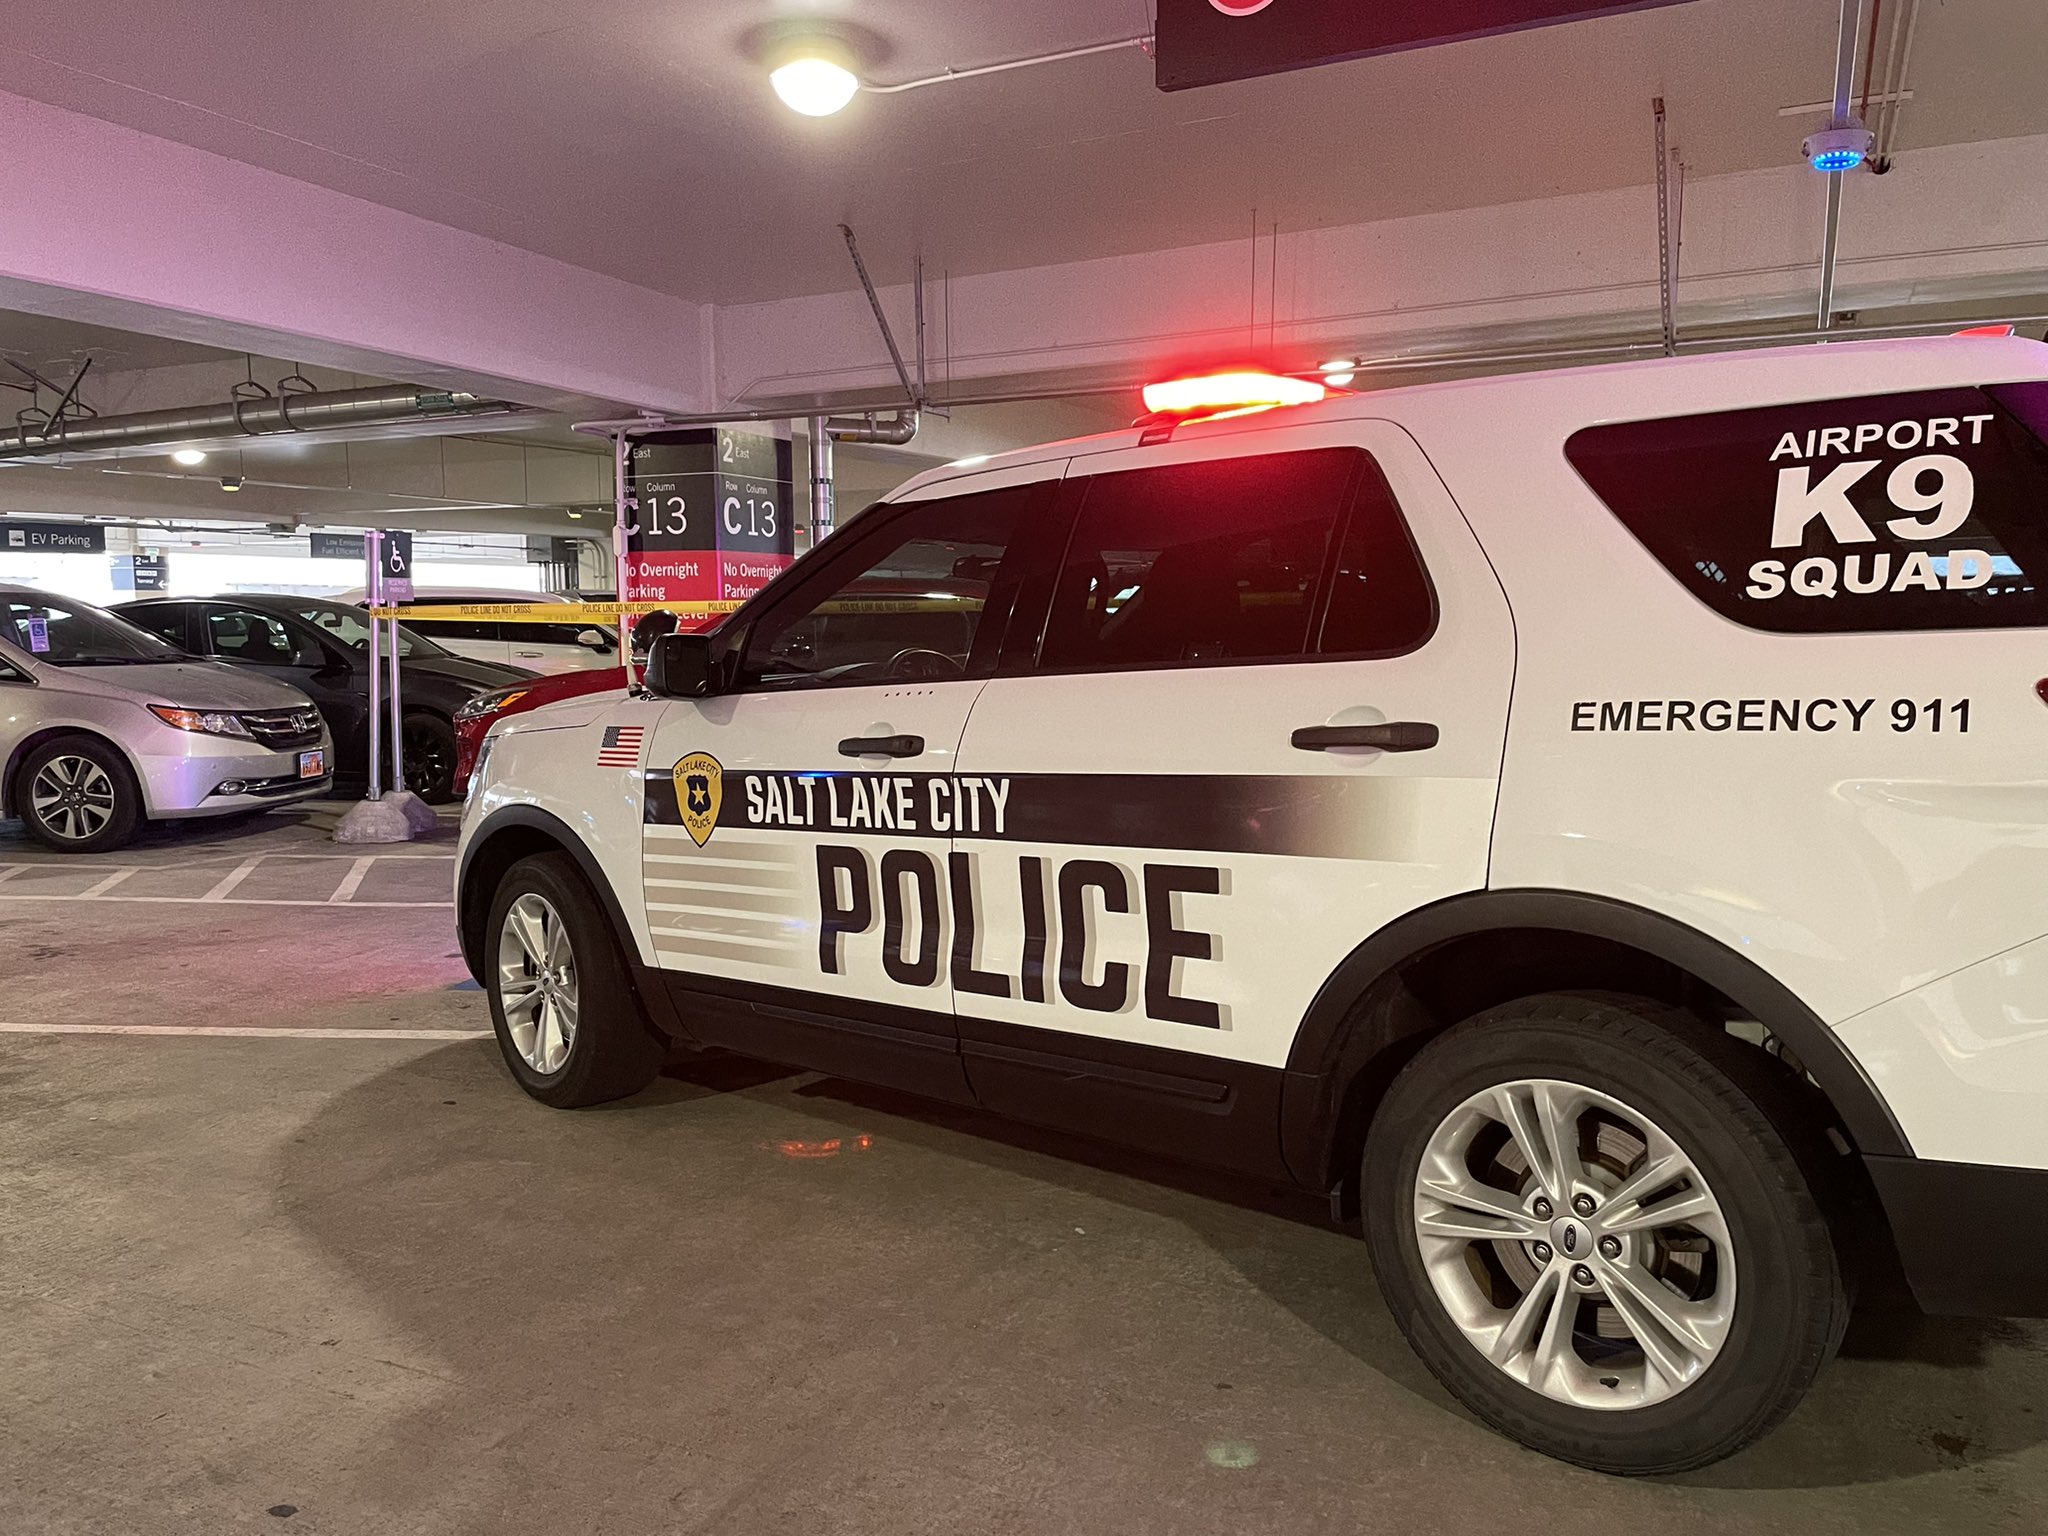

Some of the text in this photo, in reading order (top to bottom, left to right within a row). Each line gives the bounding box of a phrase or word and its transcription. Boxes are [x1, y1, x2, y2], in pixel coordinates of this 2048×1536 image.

[1769, 414, 1994, 461] AIRPORT
[633, 449, 651, 459] East
[722, 437, 750, 463] 2 East
[647, 483, 676, 493] Column
[725, 481, 768, 495] Row Column
[1771, 454, 1974, 549] K9
[647, 497, 687, 535] 13
[723, 496, 776, 538] C 13
[31, 533, 91, 547] EV Parking
[640, 562, 699, 579] Overnight
[723, 562, 782, 581] No Overnight
[1746, 549, 1993, 600] SQUAD
[393, 606, 411, 616] CROSS
[460, 604, 532, 615] POLICE LINE DO NOT CROSS
[582, 602, 656, 613] POLICE LINE DO NOT CROSS
[708, 602, 728, 612] POLICE
[1571, 698, 1970, 733] EMERGENCY 911
[675, 760, 720, 778] SALT LAKE CITY
[744, 775, 1010, 833] SALT LAKE CITY
[687, 815, 712, 829] POLICE
[816, 844, 1226, 1030] POLICE
